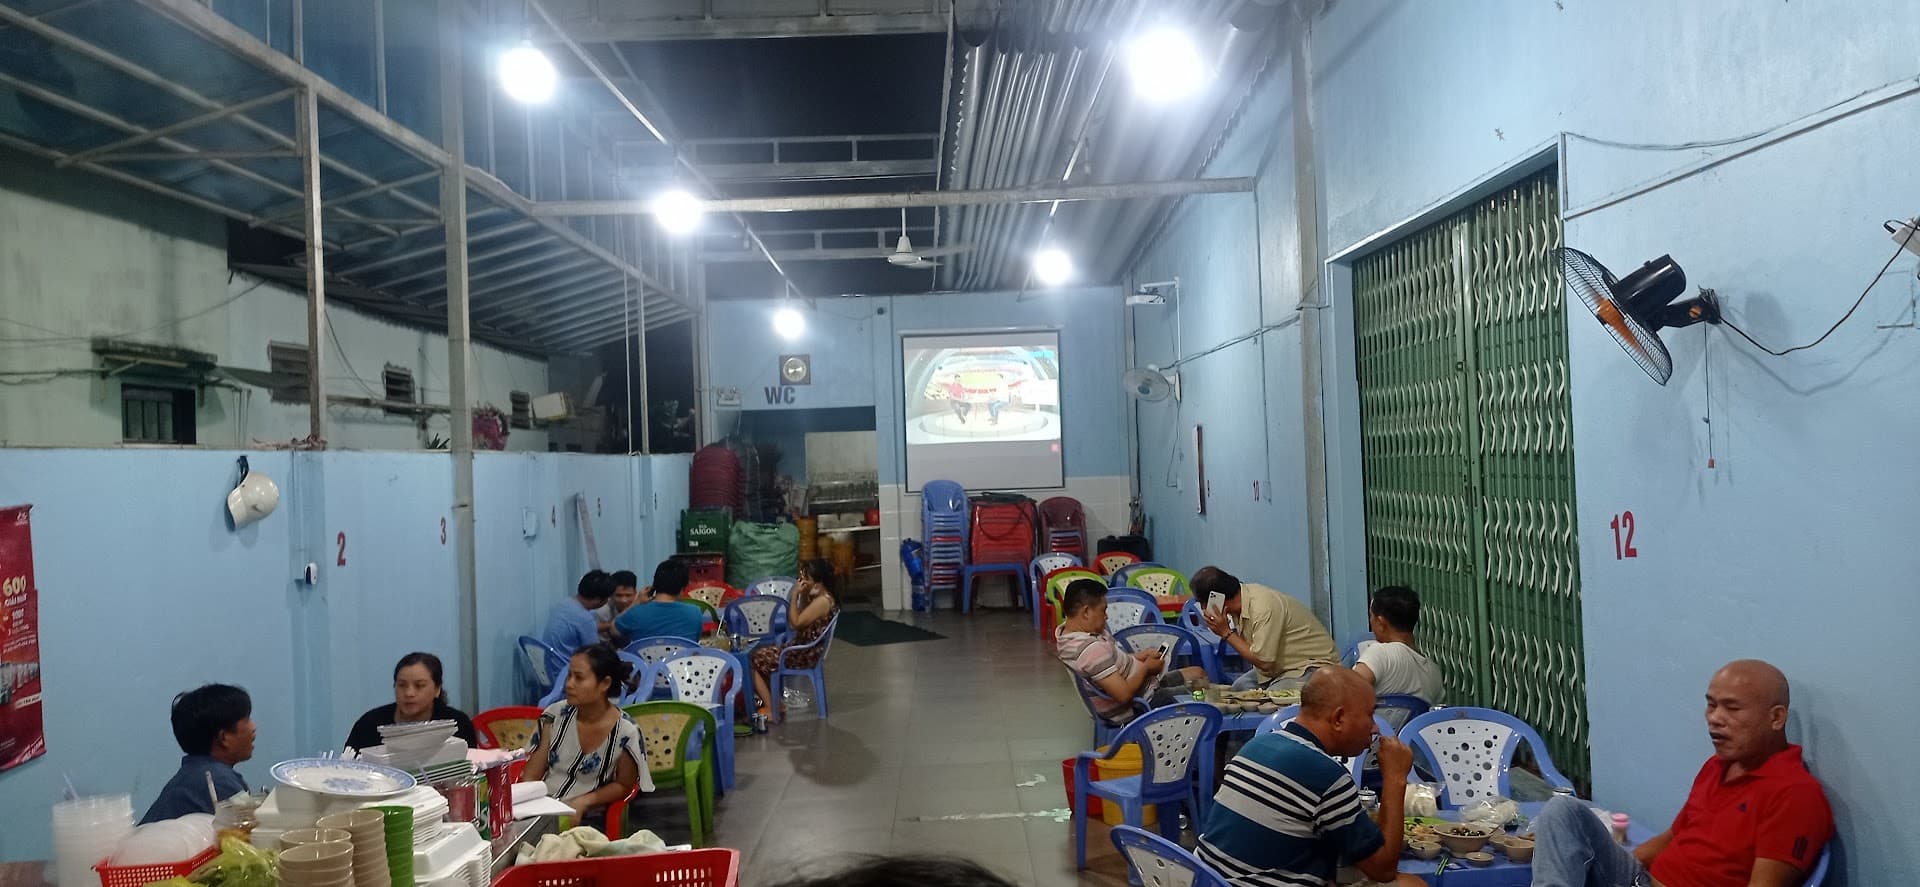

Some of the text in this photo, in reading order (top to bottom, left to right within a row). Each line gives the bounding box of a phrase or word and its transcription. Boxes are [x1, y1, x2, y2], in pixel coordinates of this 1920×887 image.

[764, 386, 796, 405] WC
[440, 516, 447, 545] 3
[1610, 510, 1637, 560] 12
[336, 531, 346, 567] 2
[2, 574, 27, 598] 600
